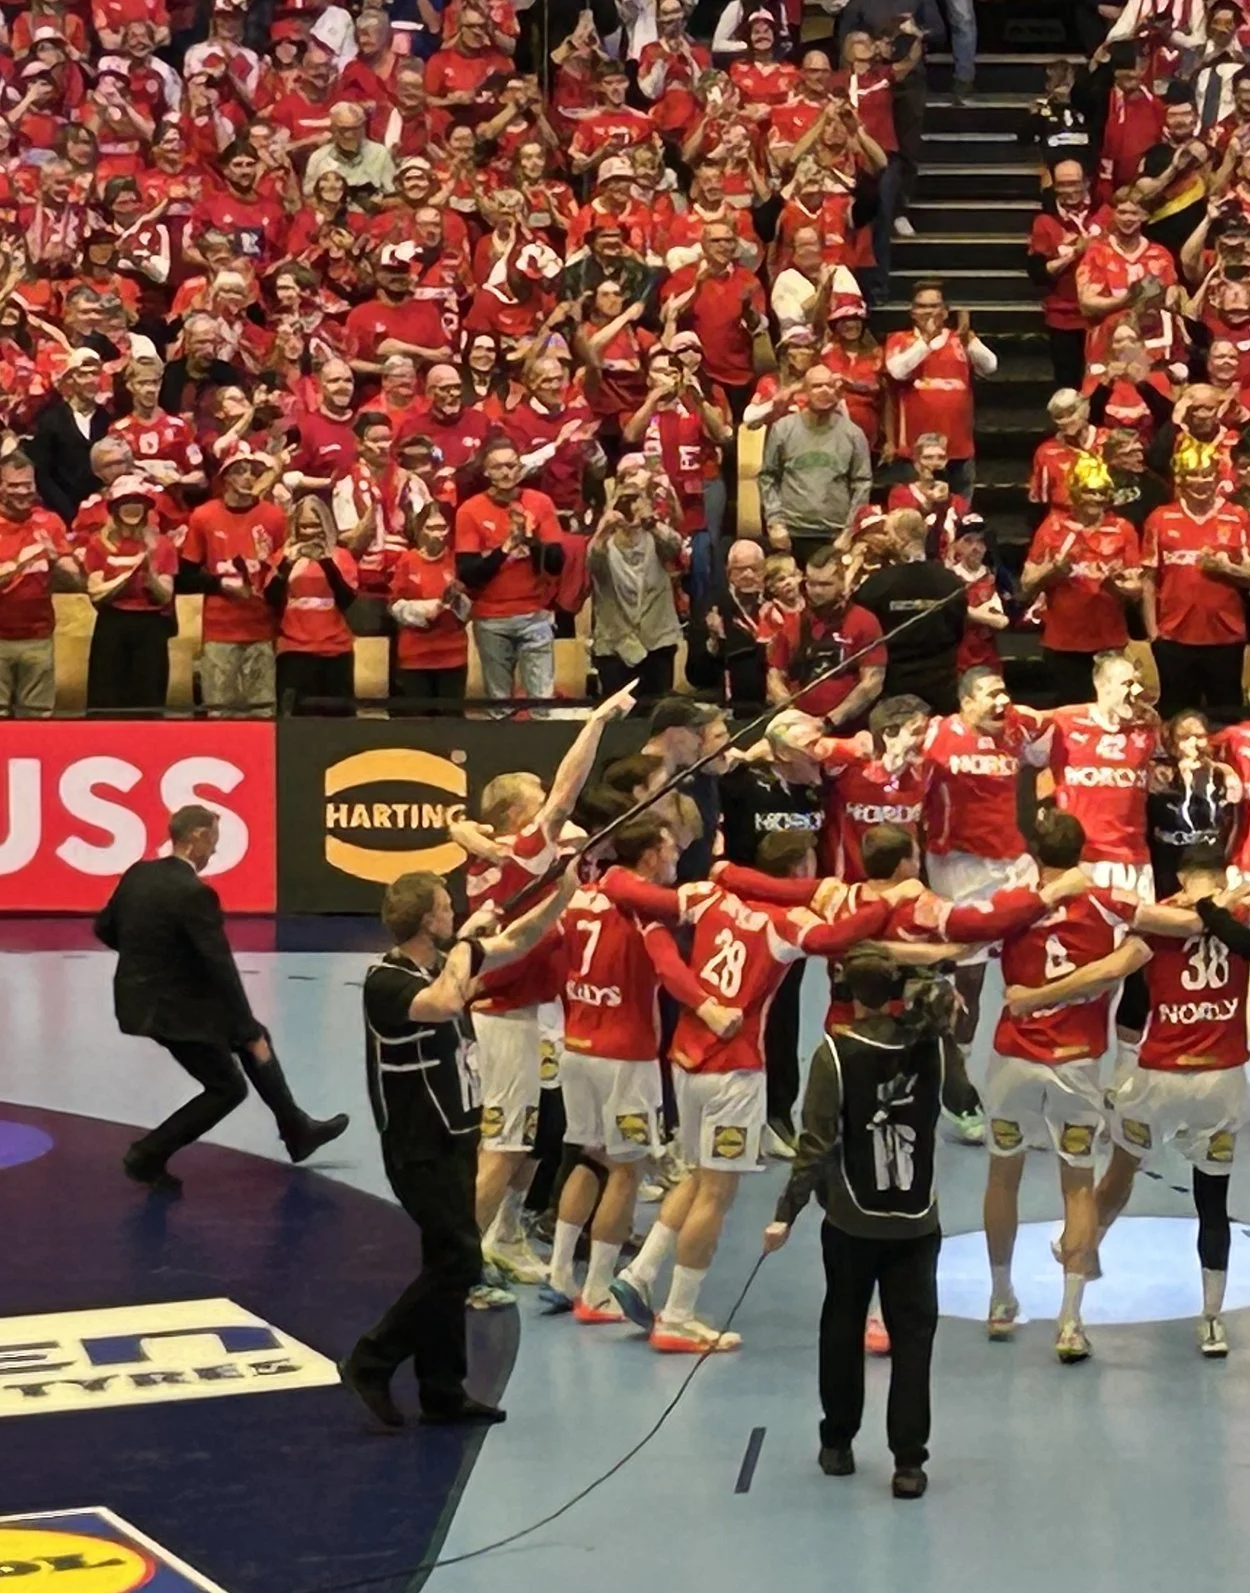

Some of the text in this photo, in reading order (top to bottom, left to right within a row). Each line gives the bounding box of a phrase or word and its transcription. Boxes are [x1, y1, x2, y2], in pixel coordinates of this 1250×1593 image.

[326, 803, 466, 829] HARTING
[577, 919, 601, 977] 7
[700, 928, 746, 998] 28
[2, 1358, 303, 1397] TYRES
